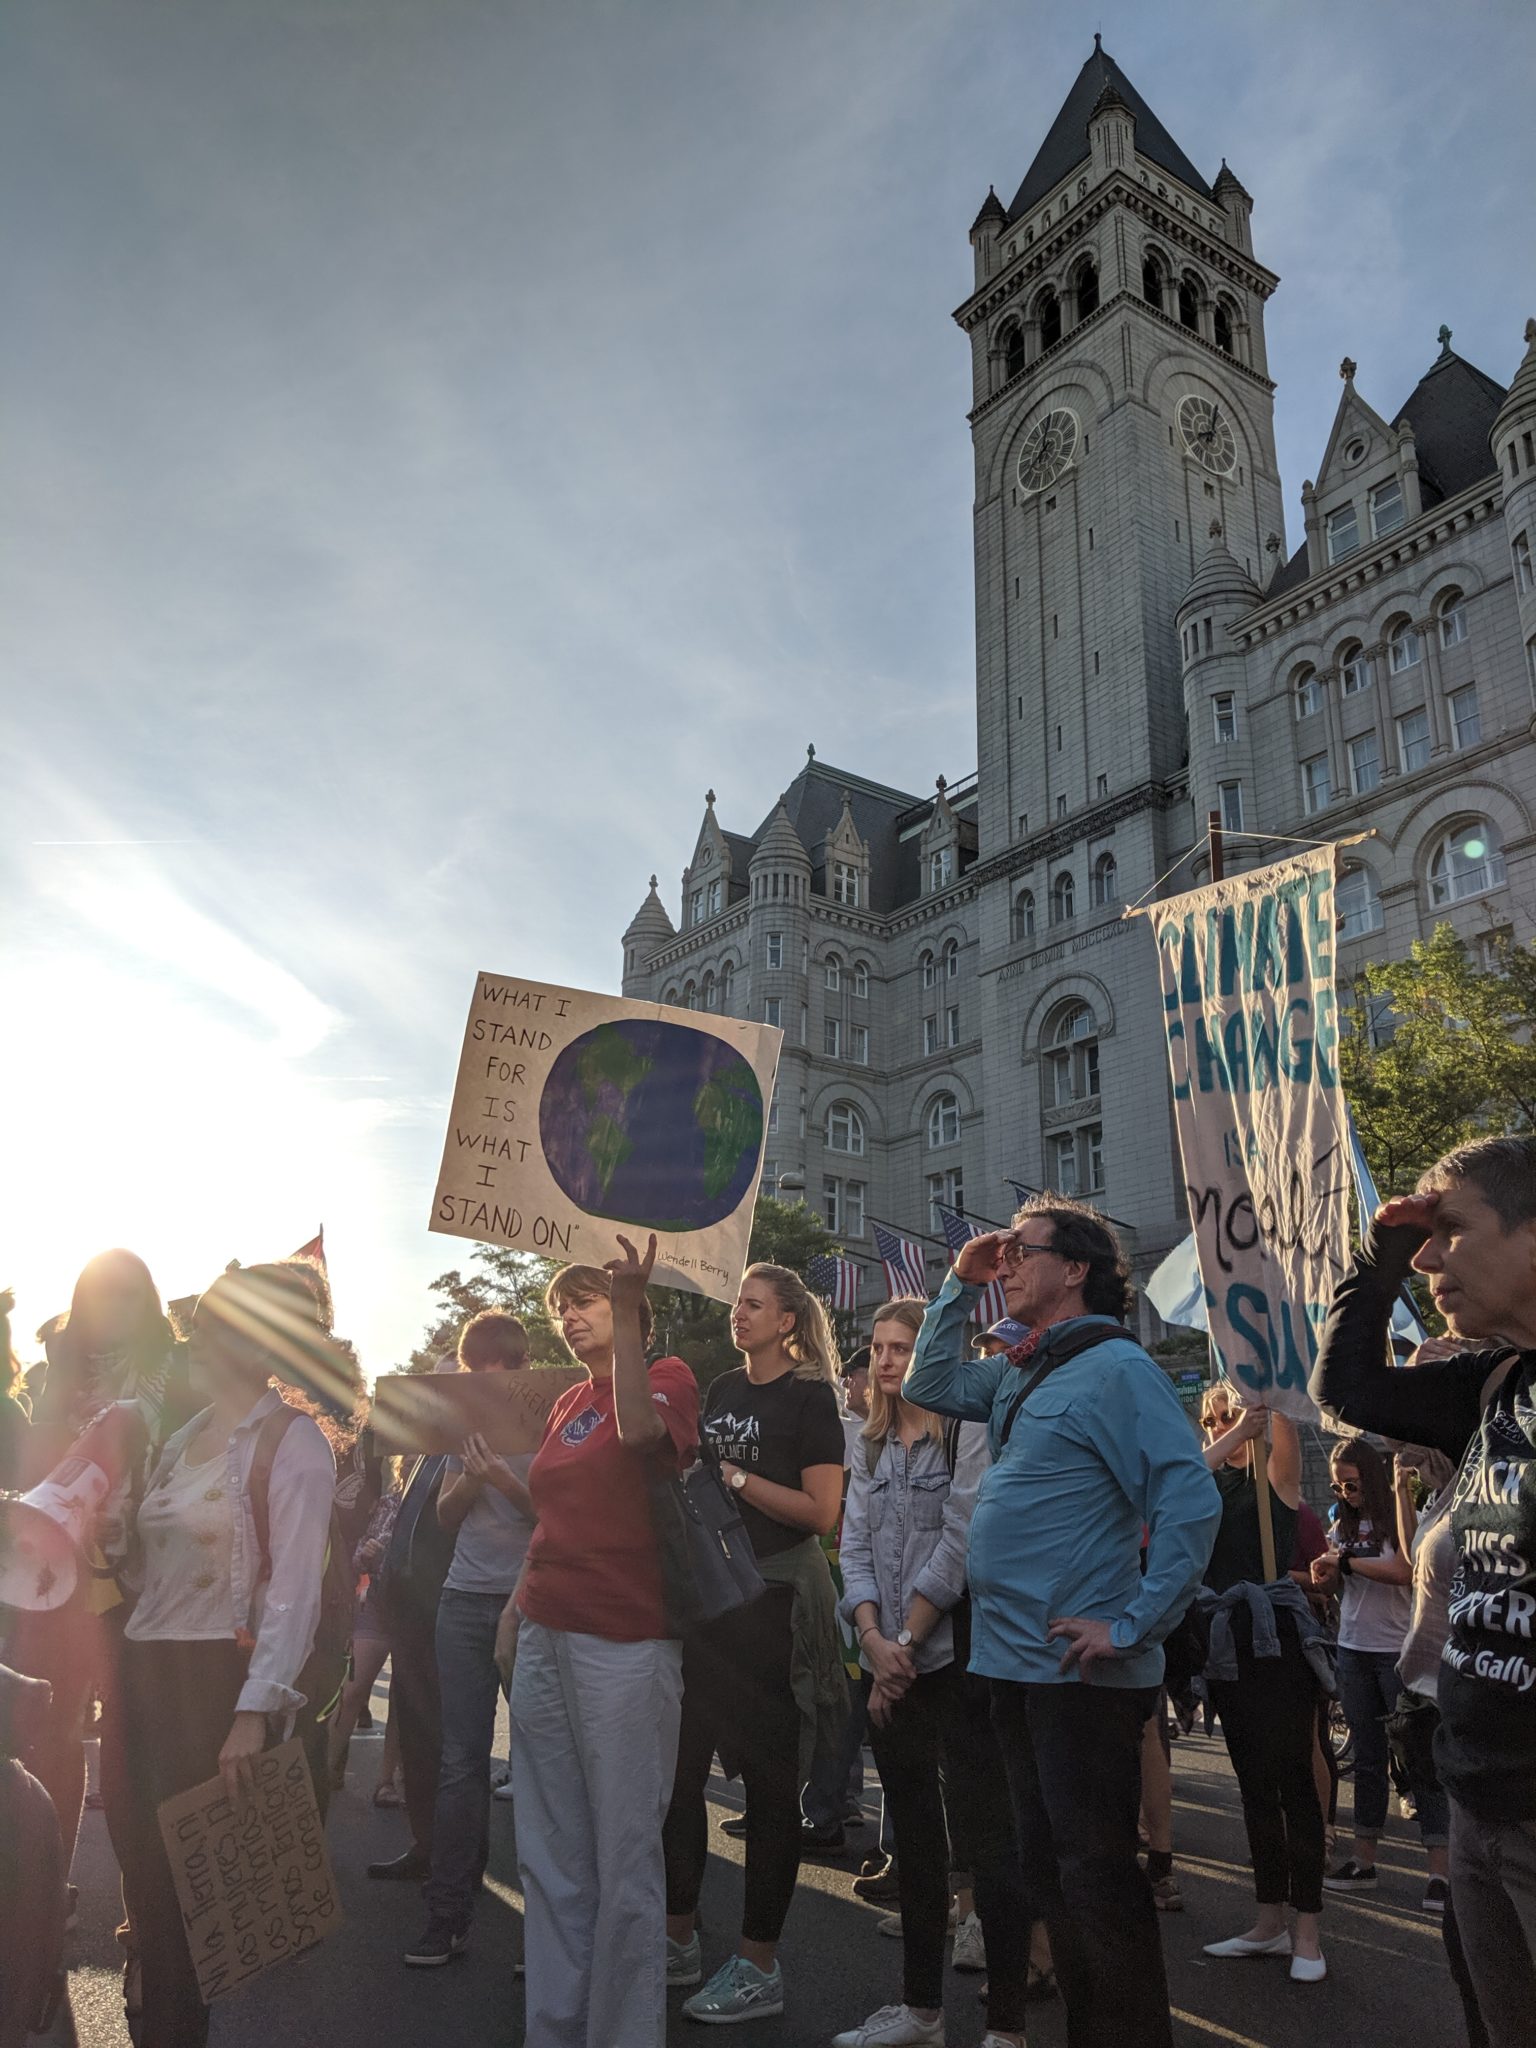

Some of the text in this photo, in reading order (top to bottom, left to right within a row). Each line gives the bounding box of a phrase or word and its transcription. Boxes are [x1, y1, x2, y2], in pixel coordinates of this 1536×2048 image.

[1159, 869, 1332, 1011] CLIMATE
[554, 999, 572, 1017] I
[473, 1019, 552, 1051] STAND
[1168, 988, 1340, 1099] CHANGE
[486, 1056, 526, 1085] FOR
[482, 1096, 517, 1122] IS
[456, 1128, 532, 1163] WHAT
[476, 1164, 498, 1188] I
[439, 1195, 523, 1239] STAND
[657, 1251, 729, 1287] Wendell Berry
[751, 1446, 759, 1461] B
[1464, 1460, 1529, 1505] LACK
[1464, 1529, 1527, 1576] IVES
[170, 1812, 201, 1842] ni
[306, 1878, 335, 1918] de
[198, 1921, 226, 1965] la
[236, 1933, 263, 1981] las
[264, 1917, 290, 1966] las
[200, 1961, 233, 1999] Ni
